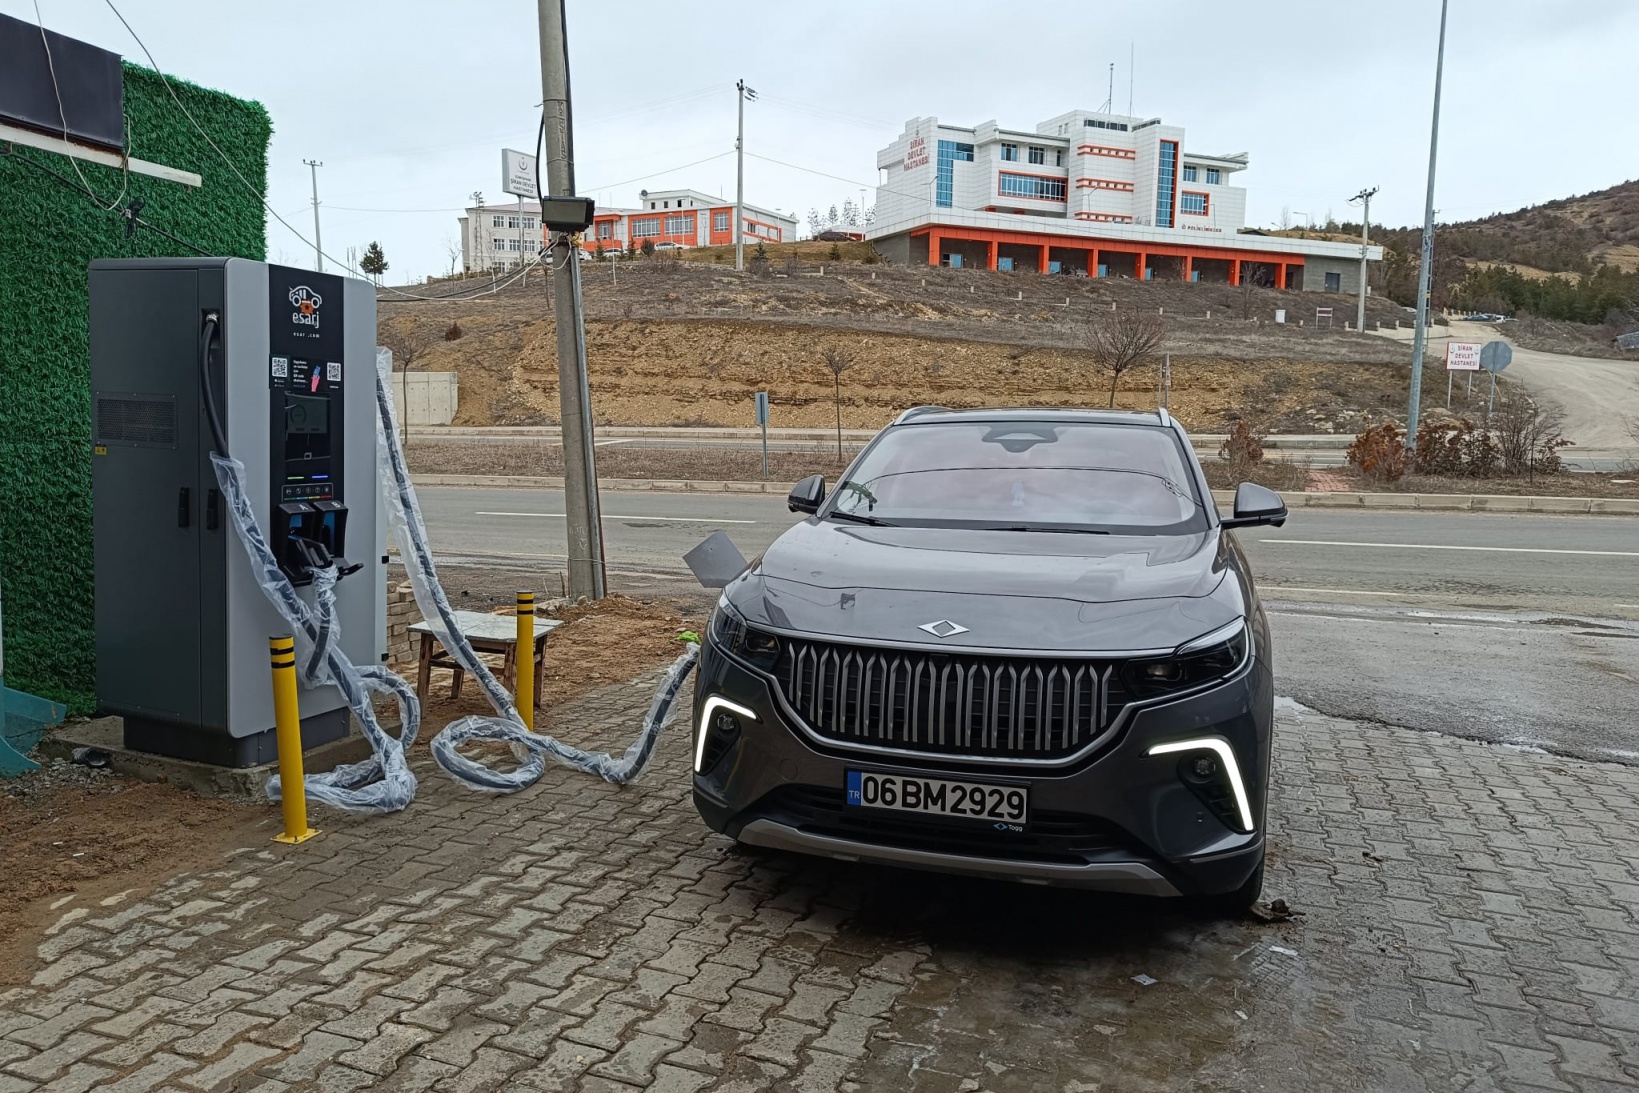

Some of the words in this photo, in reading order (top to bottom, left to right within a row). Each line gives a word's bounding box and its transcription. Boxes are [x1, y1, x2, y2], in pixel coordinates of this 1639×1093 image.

[908, 146, 926, 160] DEVLET
[849, 790, 860, 799] TR
[1008, 824, 1023, 832] Togg
